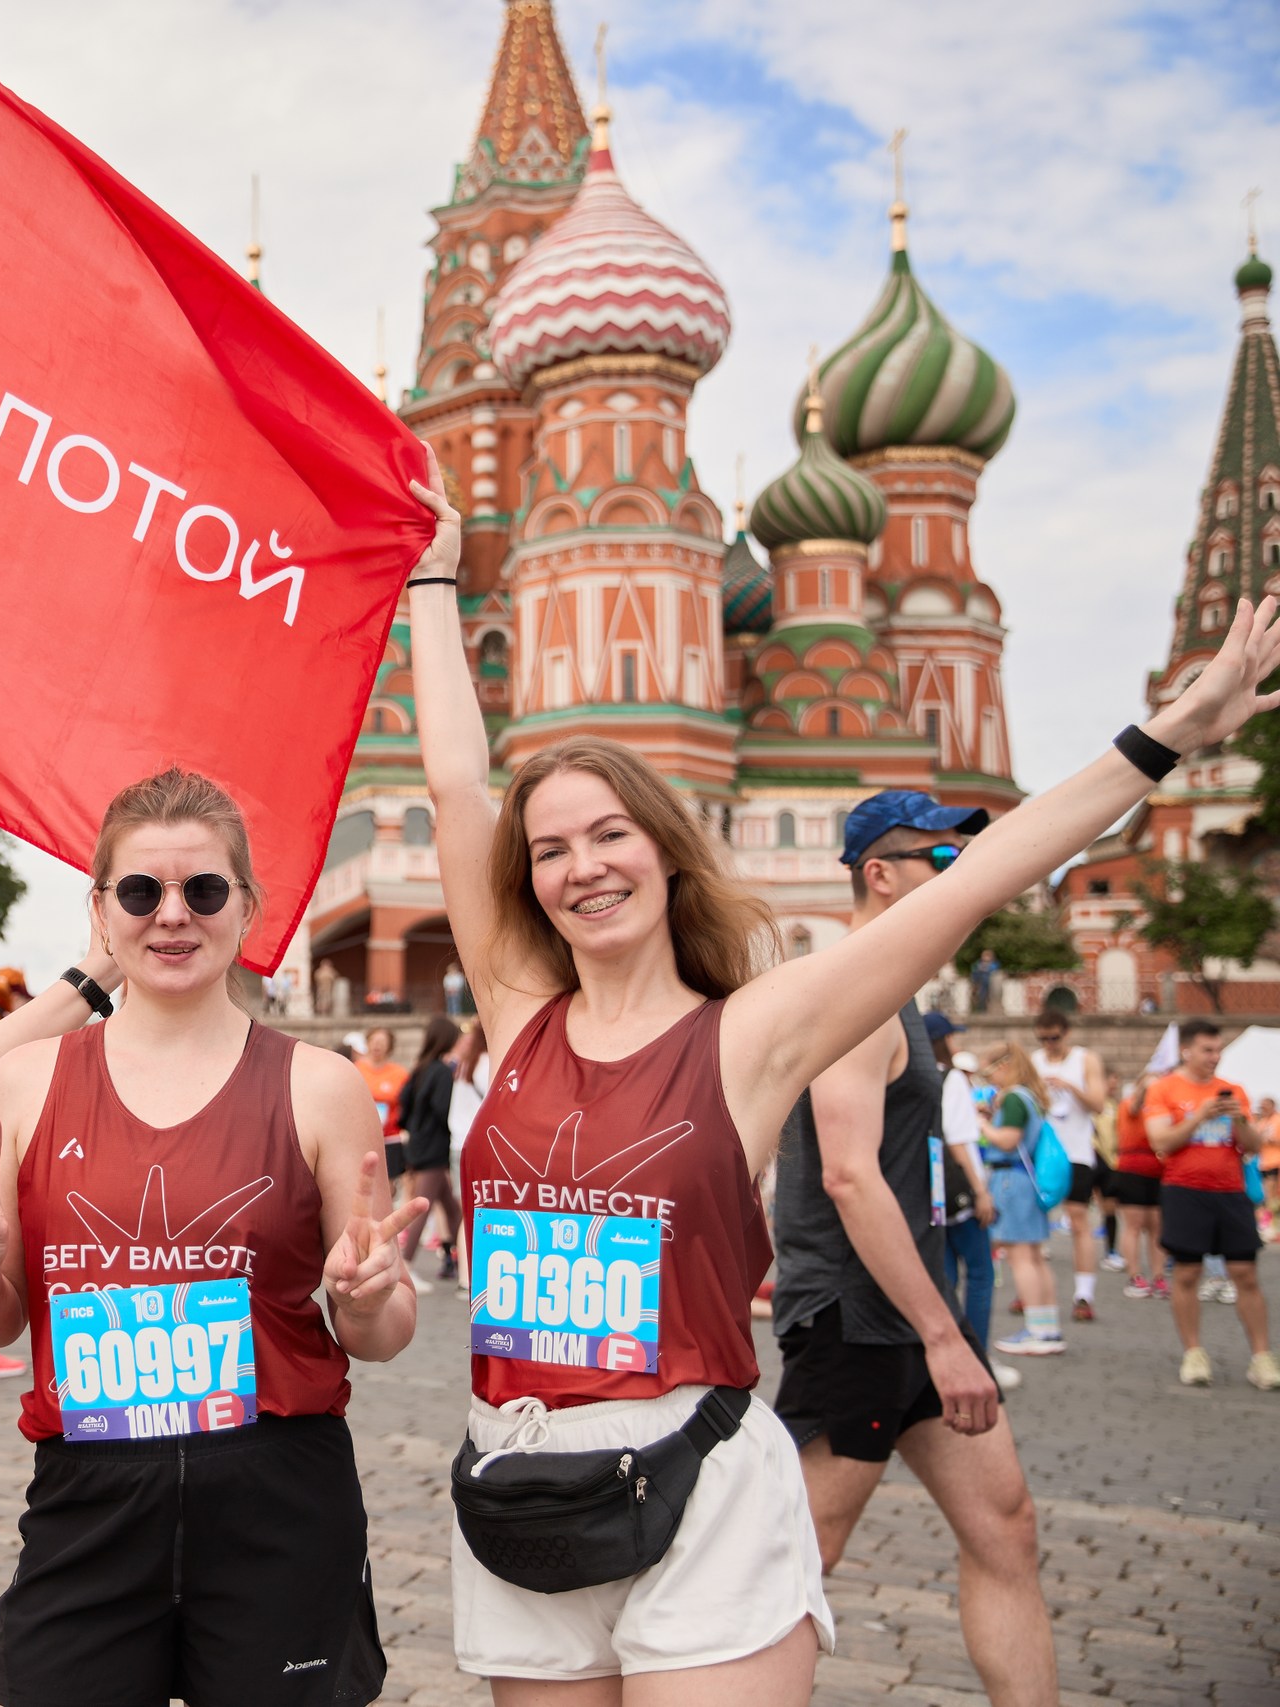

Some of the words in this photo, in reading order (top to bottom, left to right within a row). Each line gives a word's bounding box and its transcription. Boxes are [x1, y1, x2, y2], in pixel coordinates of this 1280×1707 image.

[472, 1179, 530, 1204] БЕГУ
[537, 1184, 676, 1225] ВМЕСТЕ
[492, 1225, 515, 1236] ПСБ
[550, 1219, 579, 1249] 10
[43, 1245, 120, 1269] БЕГУ
[129, 1245, 257, 1272] ВМЕСТЕ
[486, 1250, 643, 1332] 61360
[71, 1306, 94, 1318] ПСБ
[132, 1291, 163, 1323] 10
[64, 1320, 241, 1403] 60997
[206, 1395, 235, 1430] E
[294, 1658, 328, 1671] DEMIX
